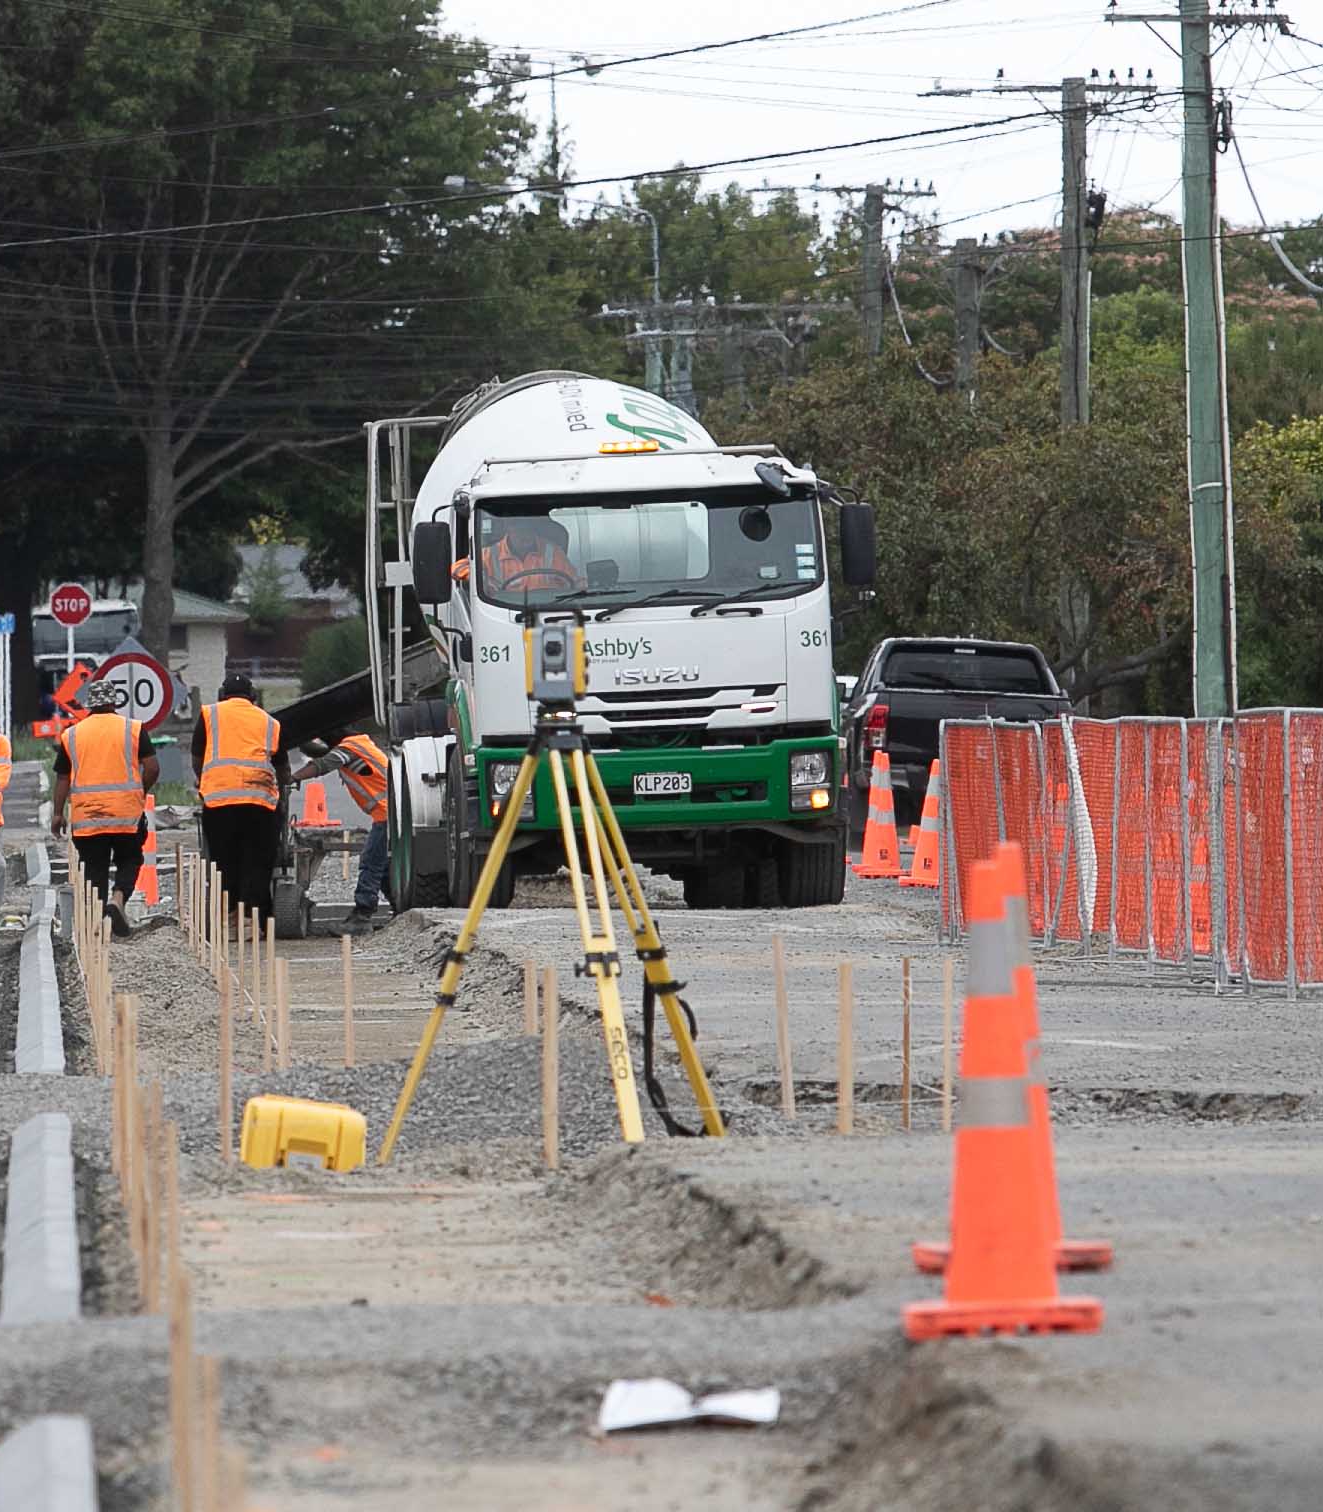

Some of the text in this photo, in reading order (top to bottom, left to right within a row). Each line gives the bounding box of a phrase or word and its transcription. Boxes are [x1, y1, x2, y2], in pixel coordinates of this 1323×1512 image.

[54, 598, 89, 613] STOP
[583, 637, 653, 660] Ashby's
[800, 629, 829, 648] 361
[480, 644, 510, 664] 361
[614, 664, 700, 686] ISUZU
[111, 678, 155, 708] 50
[635, 775, 691, 792] KLP203
